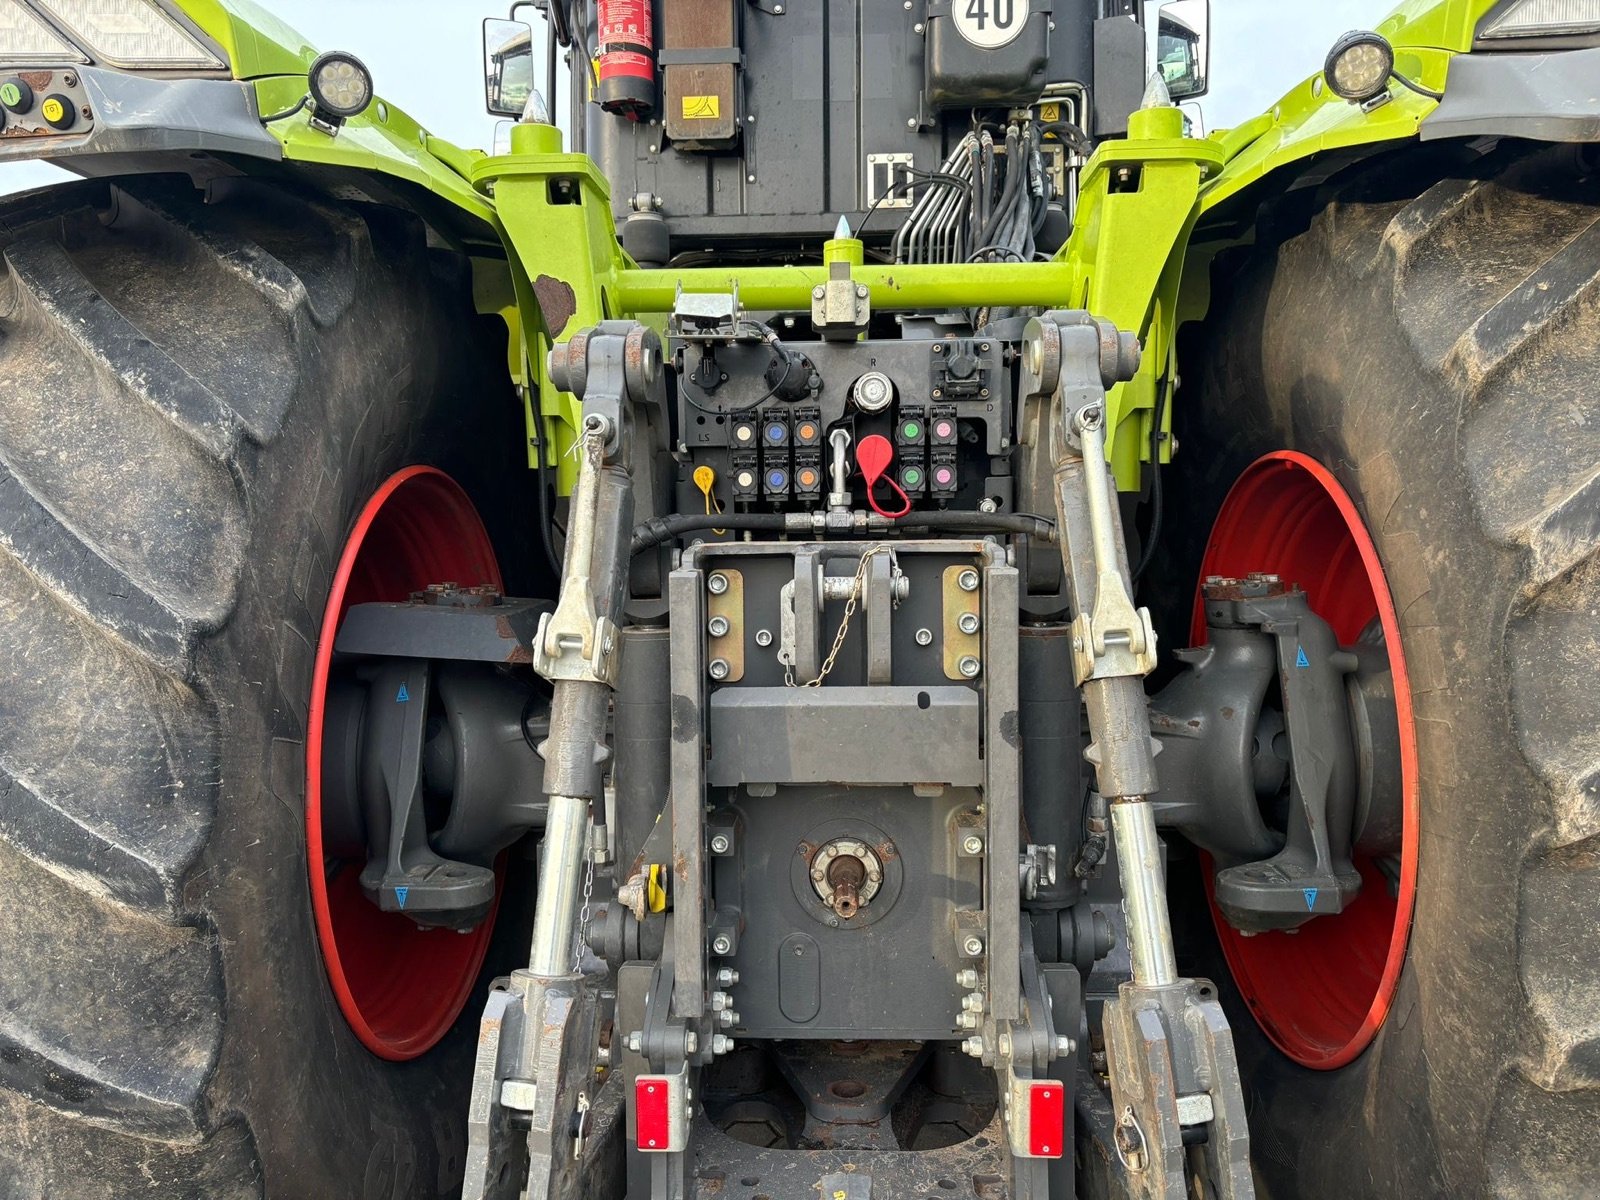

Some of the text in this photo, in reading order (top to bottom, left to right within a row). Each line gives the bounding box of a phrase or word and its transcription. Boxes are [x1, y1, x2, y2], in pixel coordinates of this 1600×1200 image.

[965, 0, 1014, 30] 40
[870, 357, 877, 367] R
[986, 403, 994, 412] D
[698, 433, 710, 442] LS
